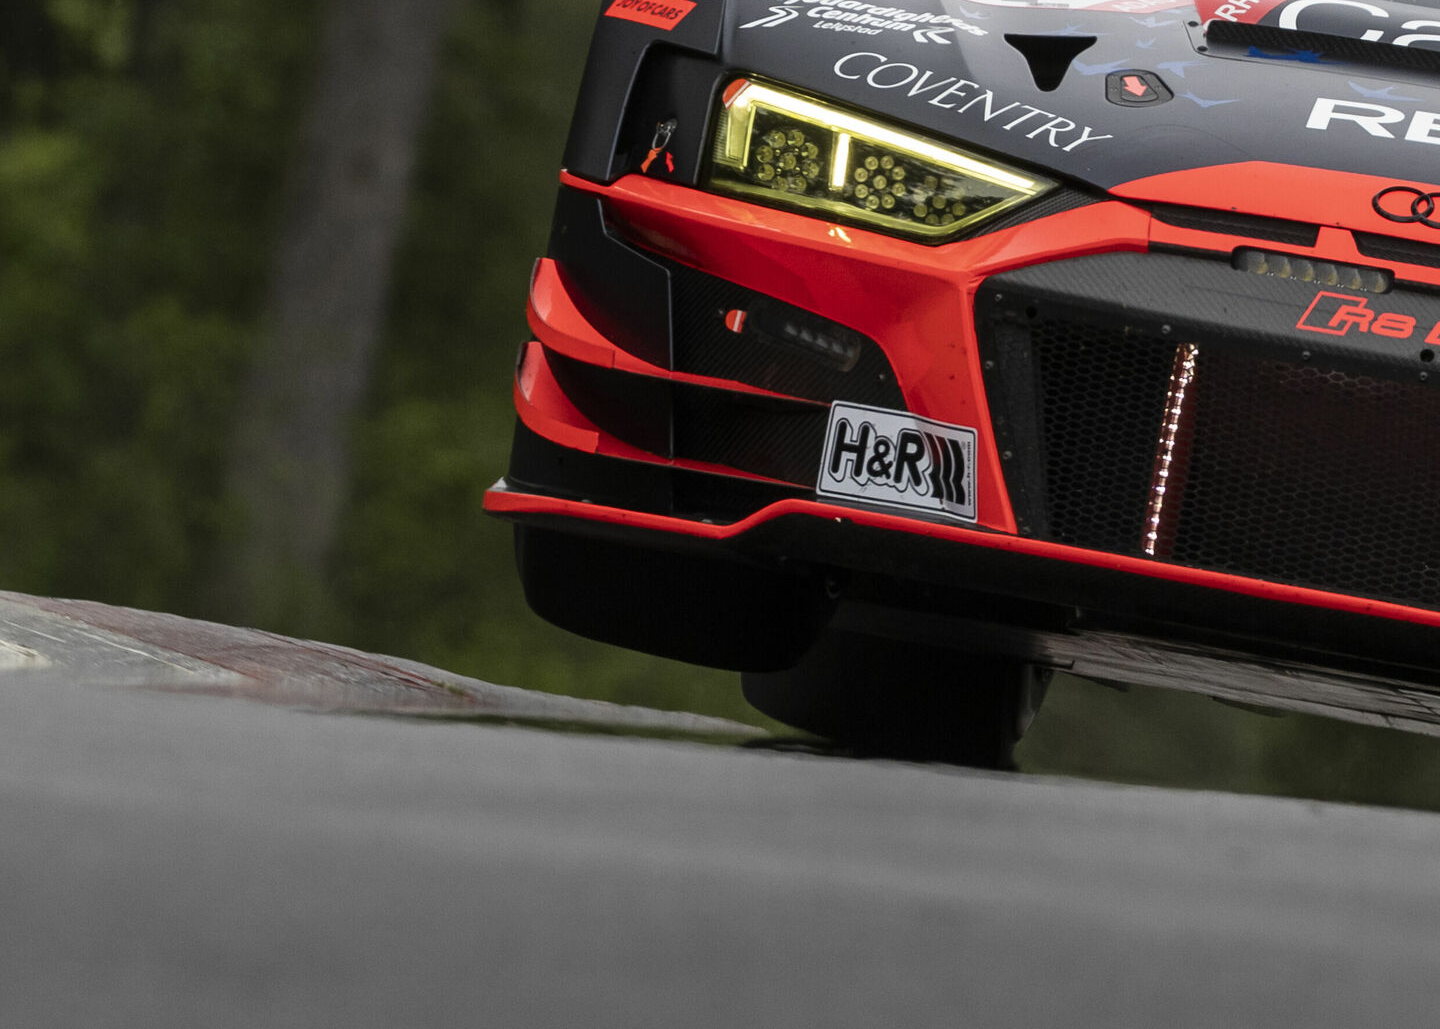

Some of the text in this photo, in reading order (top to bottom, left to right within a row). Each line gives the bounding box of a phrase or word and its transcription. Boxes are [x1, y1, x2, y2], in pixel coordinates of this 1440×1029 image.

[650, 4, 684, 21] CARS
[806, 5, 918, 32] Centrum
[812, 19, 884, 36] Lelystad
[834, 52, 1113, 152] COVENTRY
[830, 419, 930, 496] H&R
